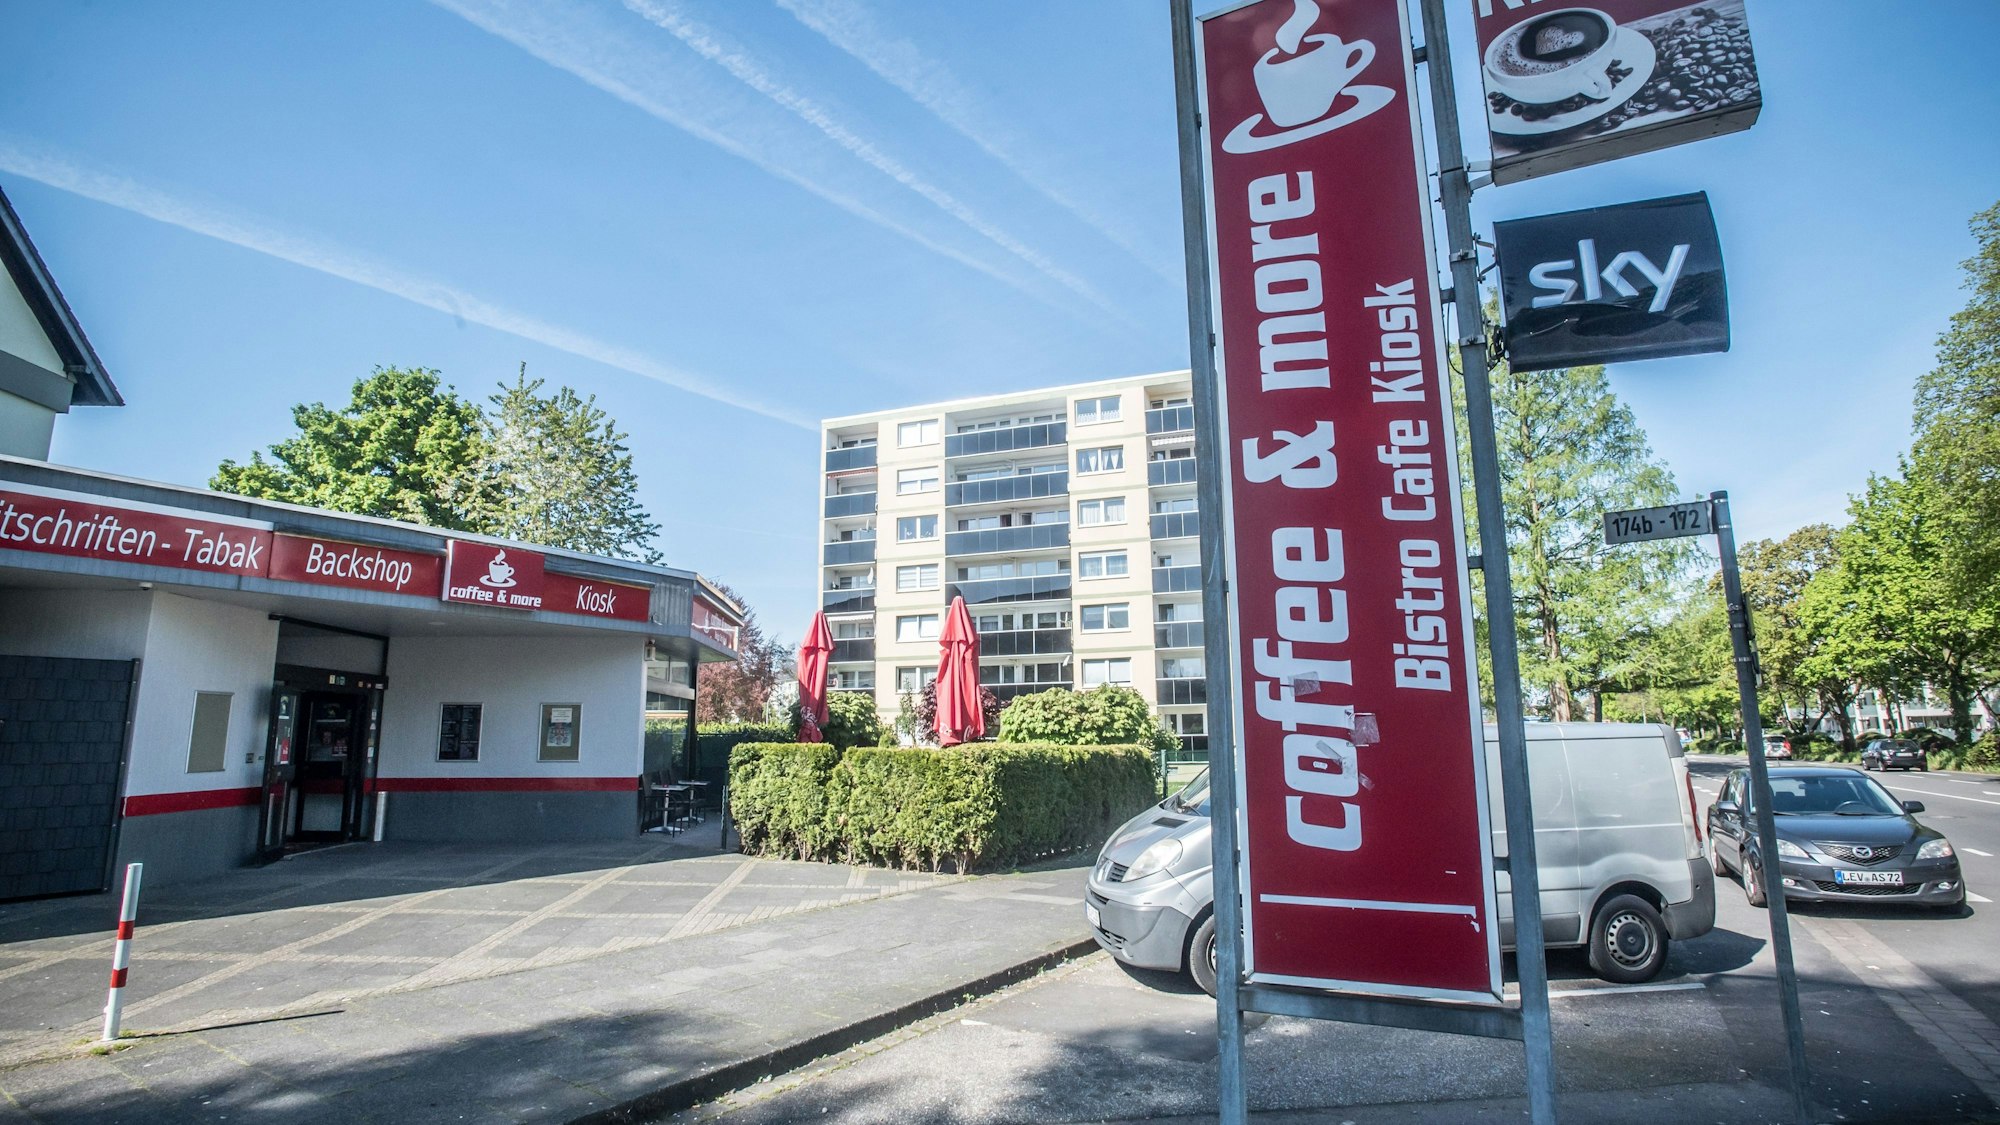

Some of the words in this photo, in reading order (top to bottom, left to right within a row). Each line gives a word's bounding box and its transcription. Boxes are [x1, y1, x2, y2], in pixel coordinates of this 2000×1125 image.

[1247, 170, 1332, 393] more
[1529, 238, 1691, 314] sky
[1363, 277, 1426, 403] Kiosk
[1241, 420, 1339, 489] &
[1376, 419, 1437, 522] Cafe
[0, 500, 157, 557] tschriften
[182, 527, 264, 570] Tabak
[1612, 515, 1653, 537] 174b
[1669, 509, 1701, 531] 172
[305, 542, 413, 591] Backshop
[450, 585, 494, 602] coffee
[496, 589, 507, 604] &
[509, 593, 542, 608] more
[575, 584, 617, 615] Kiosk
[1392, 538, 1452, 692] Bistro
[1252, 526, 1363, 852] coffee
[1842, 872, 1864, 882] LEV
